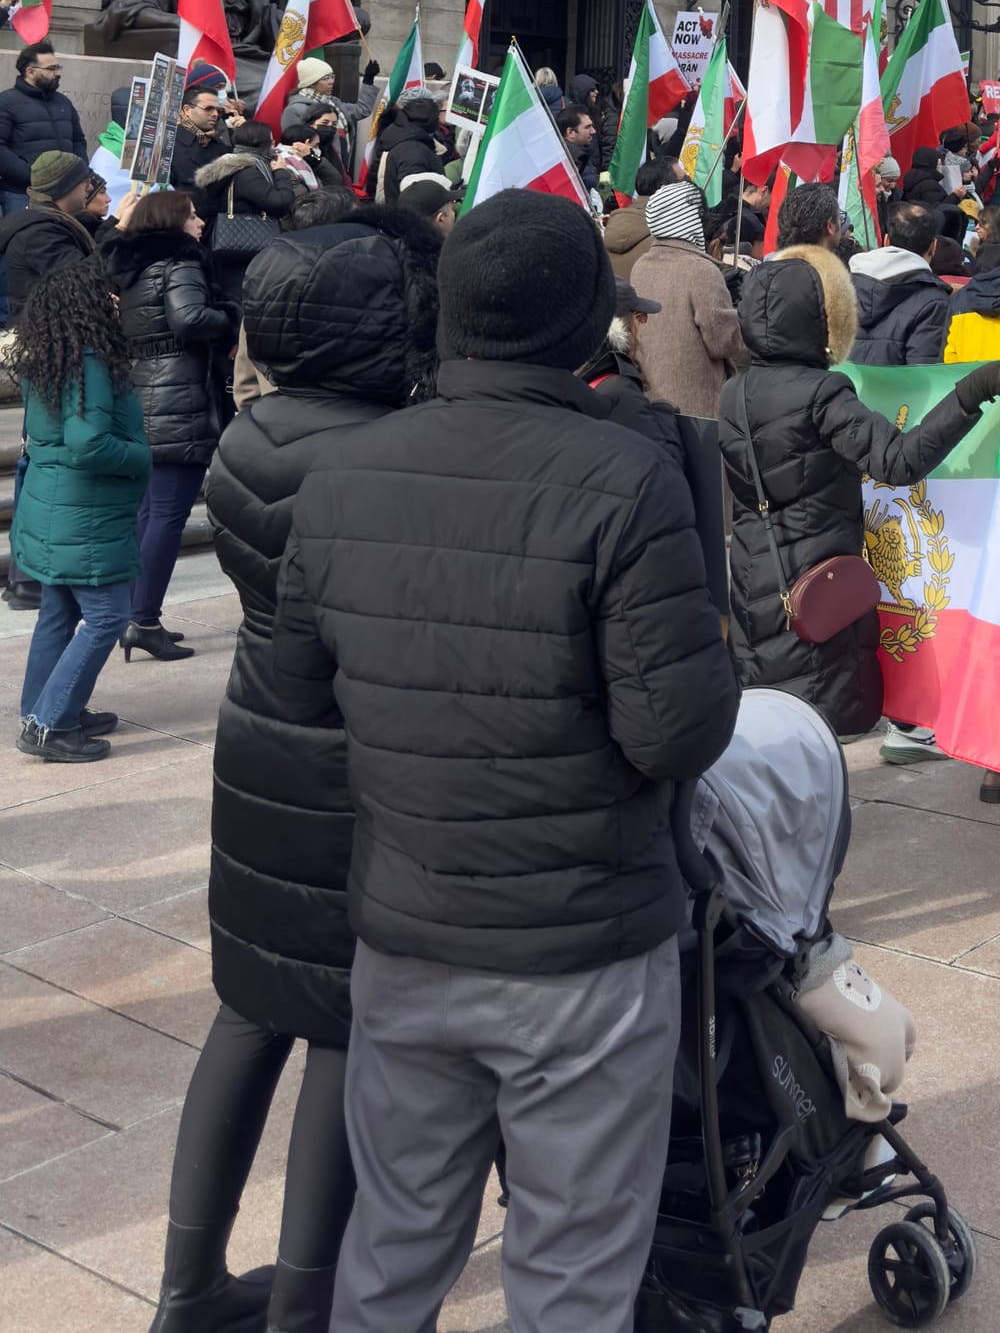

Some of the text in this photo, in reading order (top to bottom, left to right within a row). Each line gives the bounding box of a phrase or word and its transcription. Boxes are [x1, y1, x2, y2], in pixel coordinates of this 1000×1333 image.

[677, 21, 698, 32] ACT
[674, 33, 701, 45] NOW
[672, 51, 708, 59] MASSACRE
[678, 63, 698, 72] RAN
[772, 1055, 817, 1123] summer
